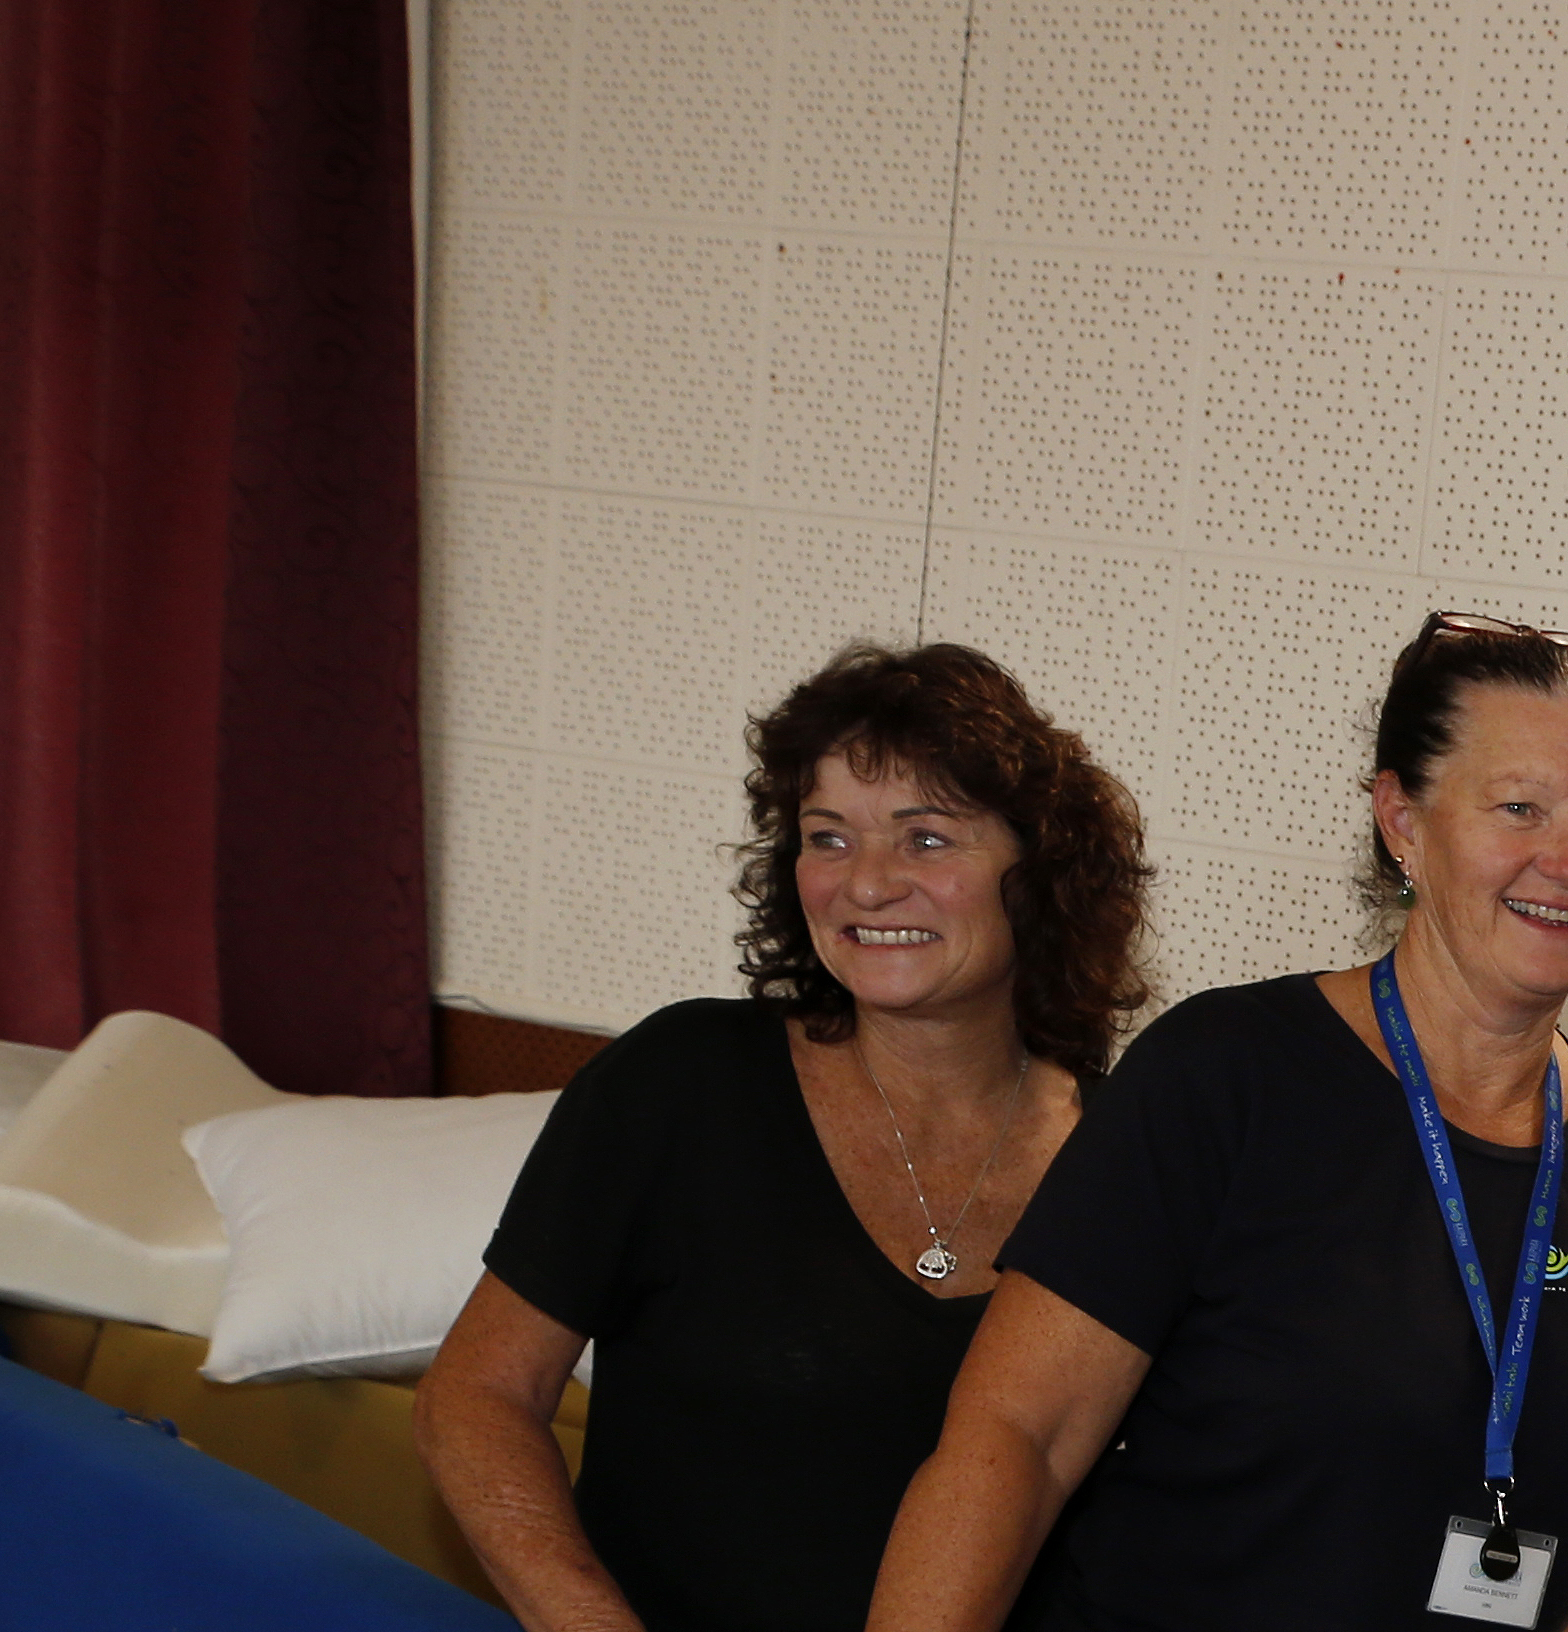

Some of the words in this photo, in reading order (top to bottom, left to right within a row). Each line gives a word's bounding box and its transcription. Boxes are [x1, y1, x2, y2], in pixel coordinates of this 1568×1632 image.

[1417, 1096, 1434, 1128] Make
[1428, 1129, 1439, 1141] it
[1431, 1142, 1449, 1185] happen
